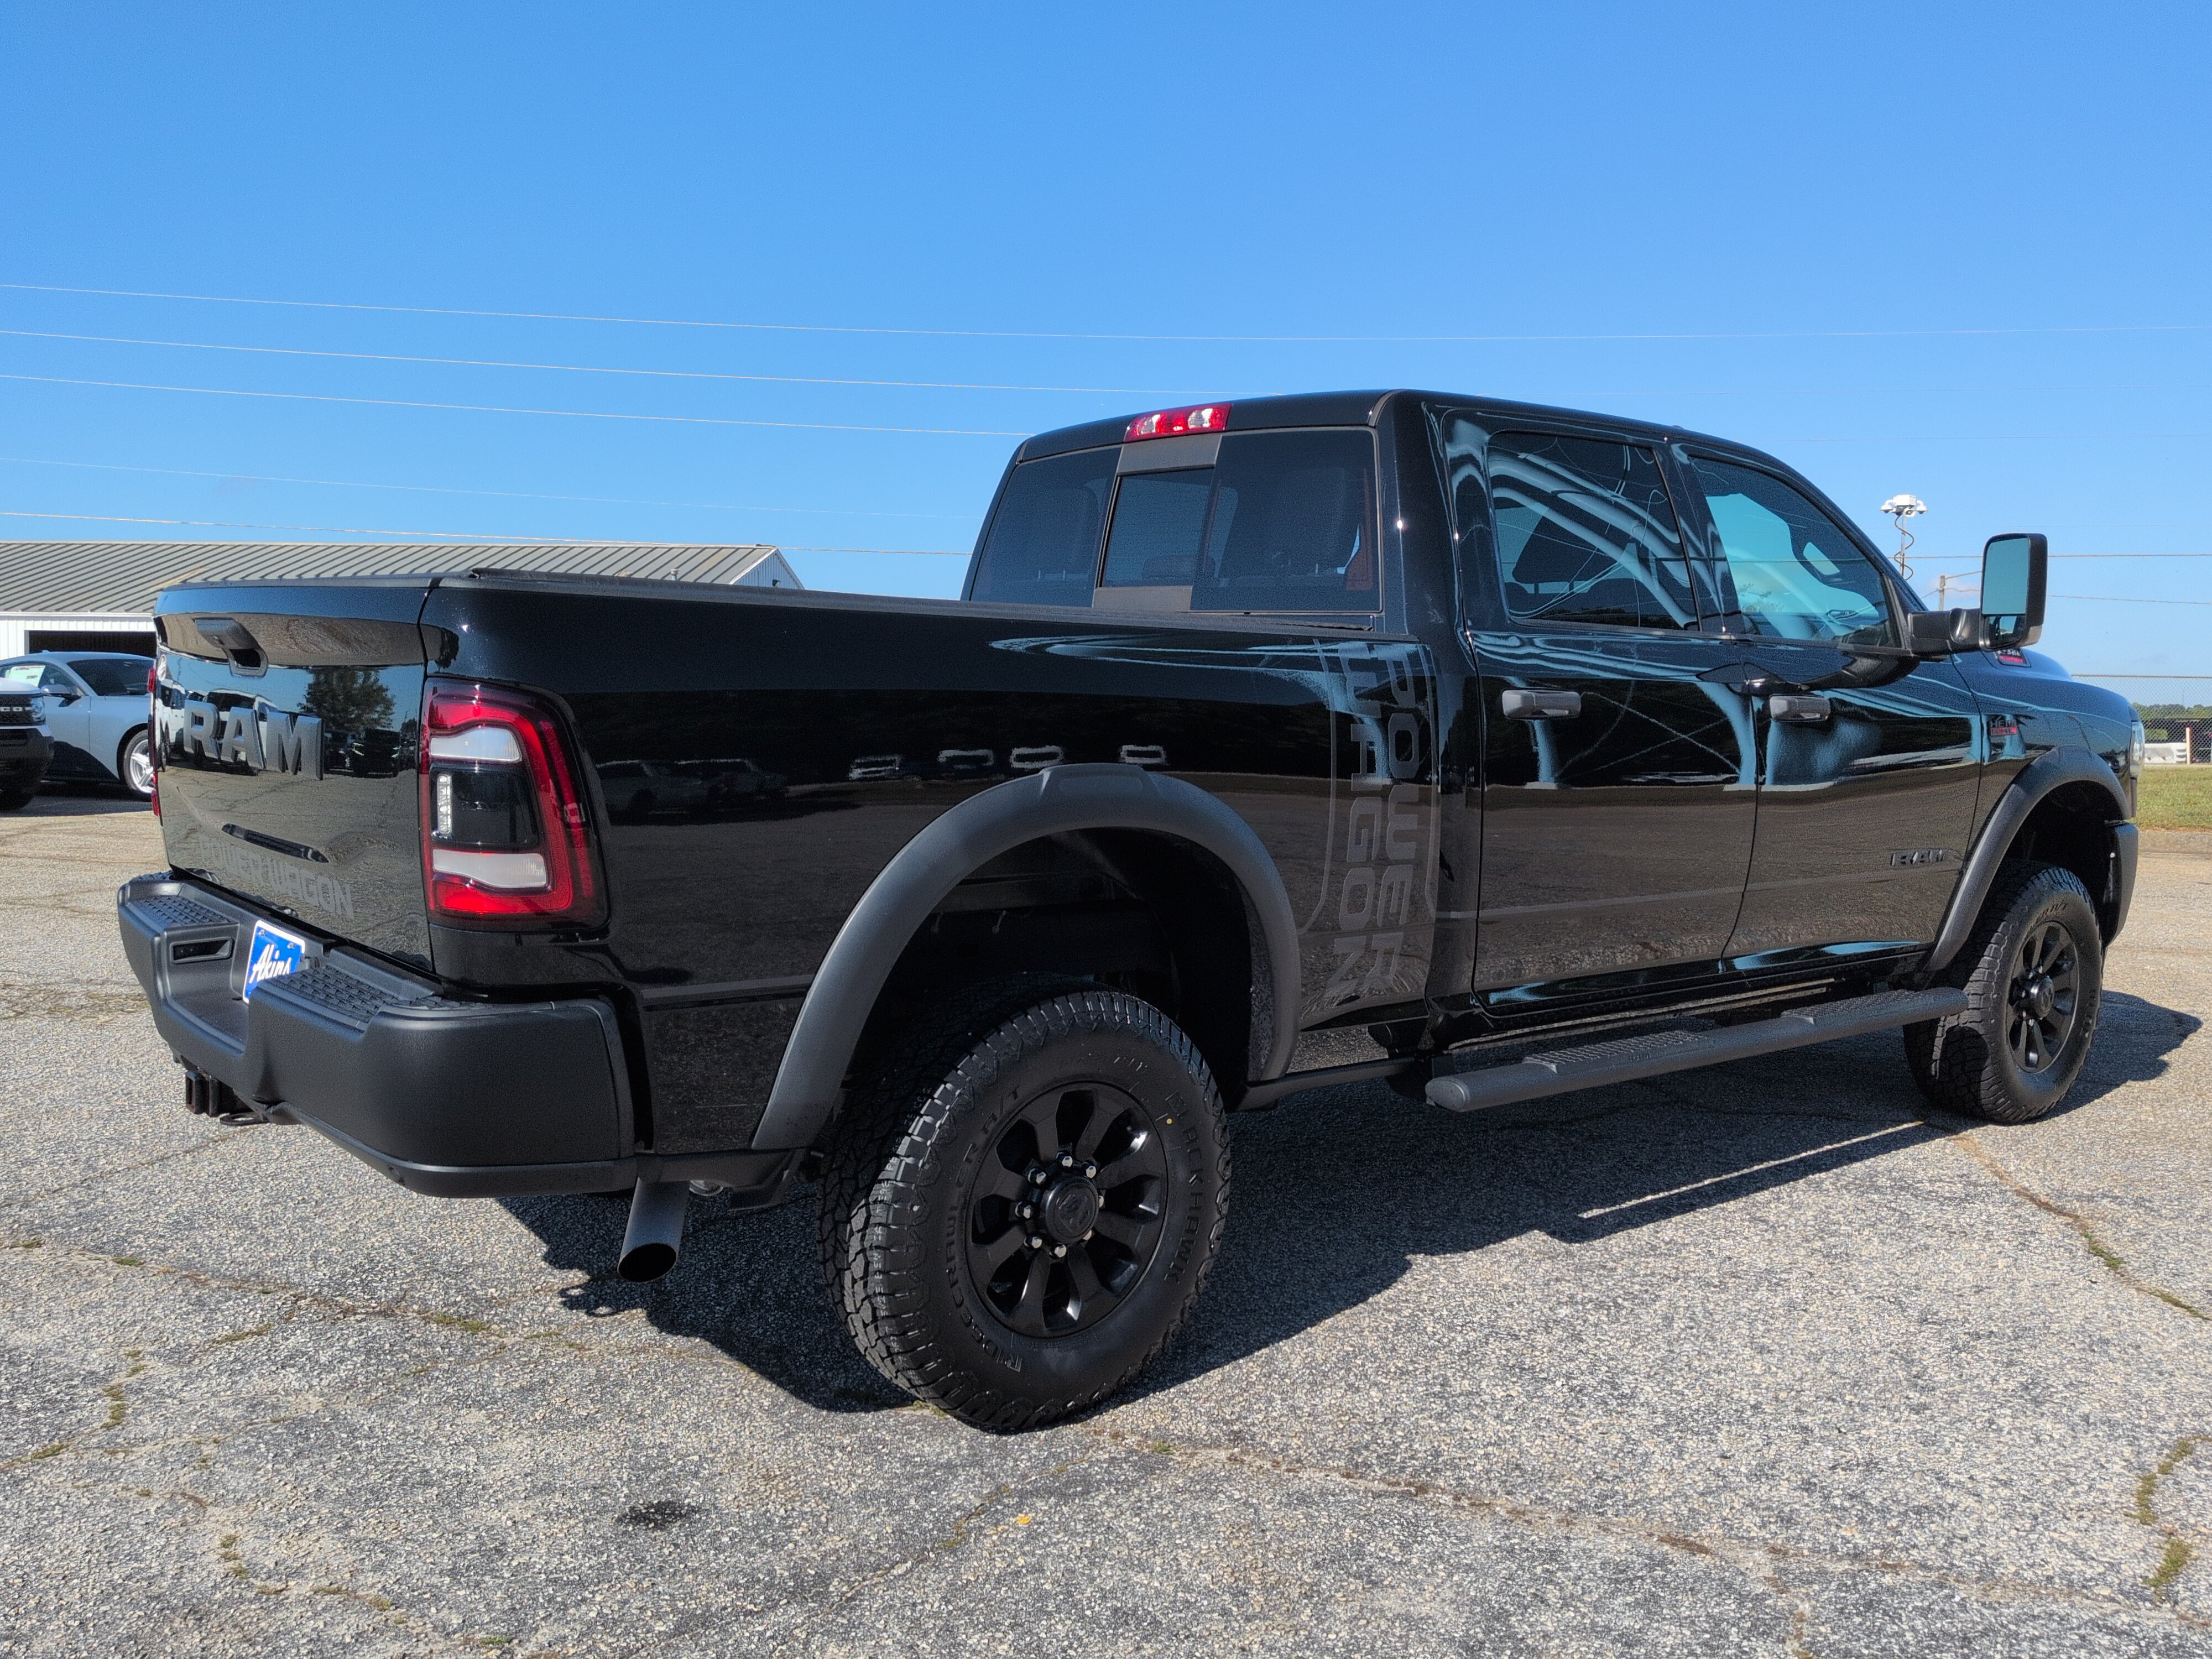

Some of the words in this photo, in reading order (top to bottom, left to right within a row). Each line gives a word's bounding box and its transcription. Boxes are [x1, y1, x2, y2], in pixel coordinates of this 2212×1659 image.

[184, 699, 325, 780] RAM
[1362, 643, 1420, 991] POWER
[1890, 848, 1948, 867] RAM
[197, 832, 265, 886] POWER
[266, 857, 354, 919] WAGON
[249, 943, 292, 984] Akins
